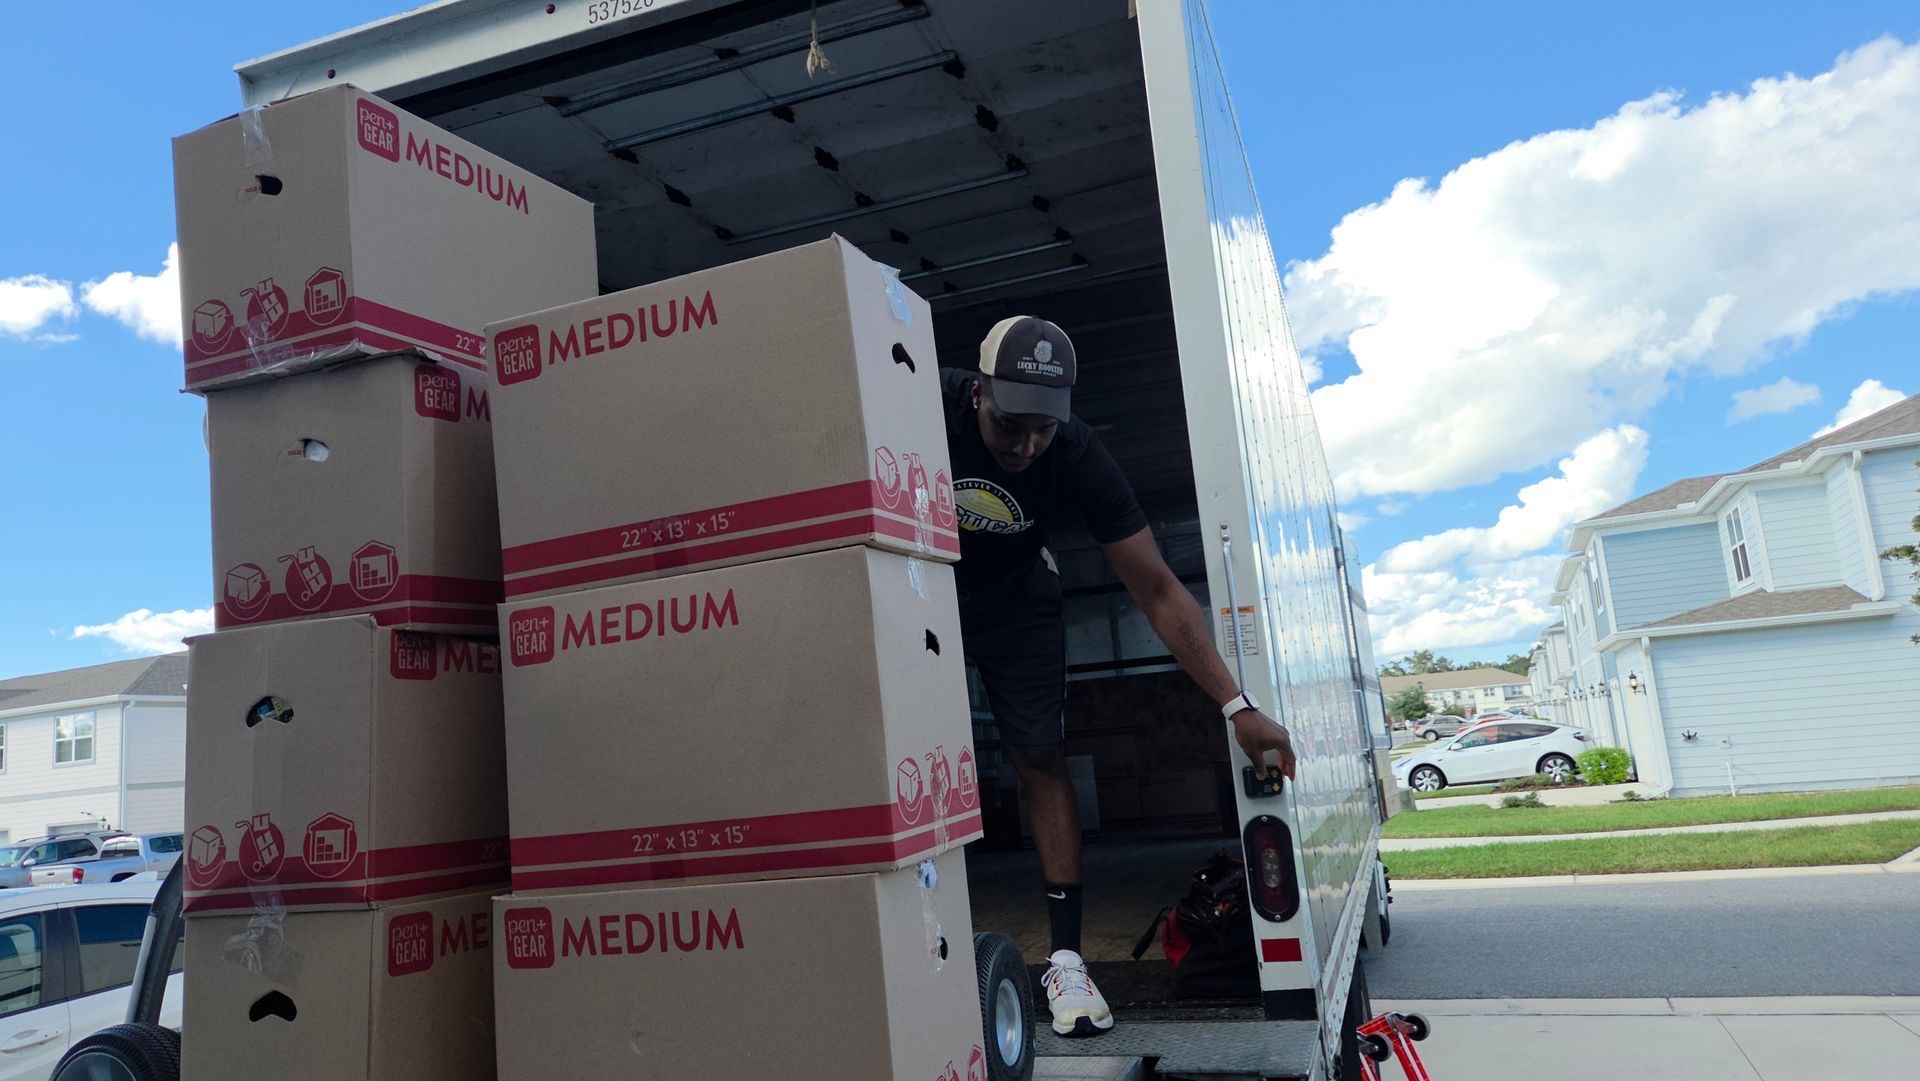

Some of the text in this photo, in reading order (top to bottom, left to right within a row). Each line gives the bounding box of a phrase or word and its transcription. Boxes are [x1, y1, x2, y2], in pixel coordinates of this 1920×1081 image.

[360, 106, 395, 132] pen+
[364, 124, 394, 153] GEAR
[406, 131, 529, 215] MEDIUM
[549, 290, 718, 365] MEDIUM
[498, 335, 534, 361] pen+
[503, 350, 534, 375] GEAR
[1017, 361, 1038, 370] LUCKY
[1038, 363, 1064, 375] ROOSTER
[419, 374, 457, 392] pen+
[424, 388, 455, 413] GEAR
[953, 482, 991, 491] ATEVER
[620, 511, 736, 548] 22" x 13" x 15"
[512, 615, 549, 641] pen+
[561, 588, 739, 651] MEDIUM
[516, 631, 547, 656] GEAR
[398, 649, 430, 670] GEAR
[632, 825, 750, 853] 22" x 13" x 15"
[392, 923, 428, 949] pen+
[508, 916, 546, 944] pen+
[562, 908, 744, 957] MEDIUM
[395, 939, 426, 965] GEAR
[514, 934, 546, 957] GEAR
